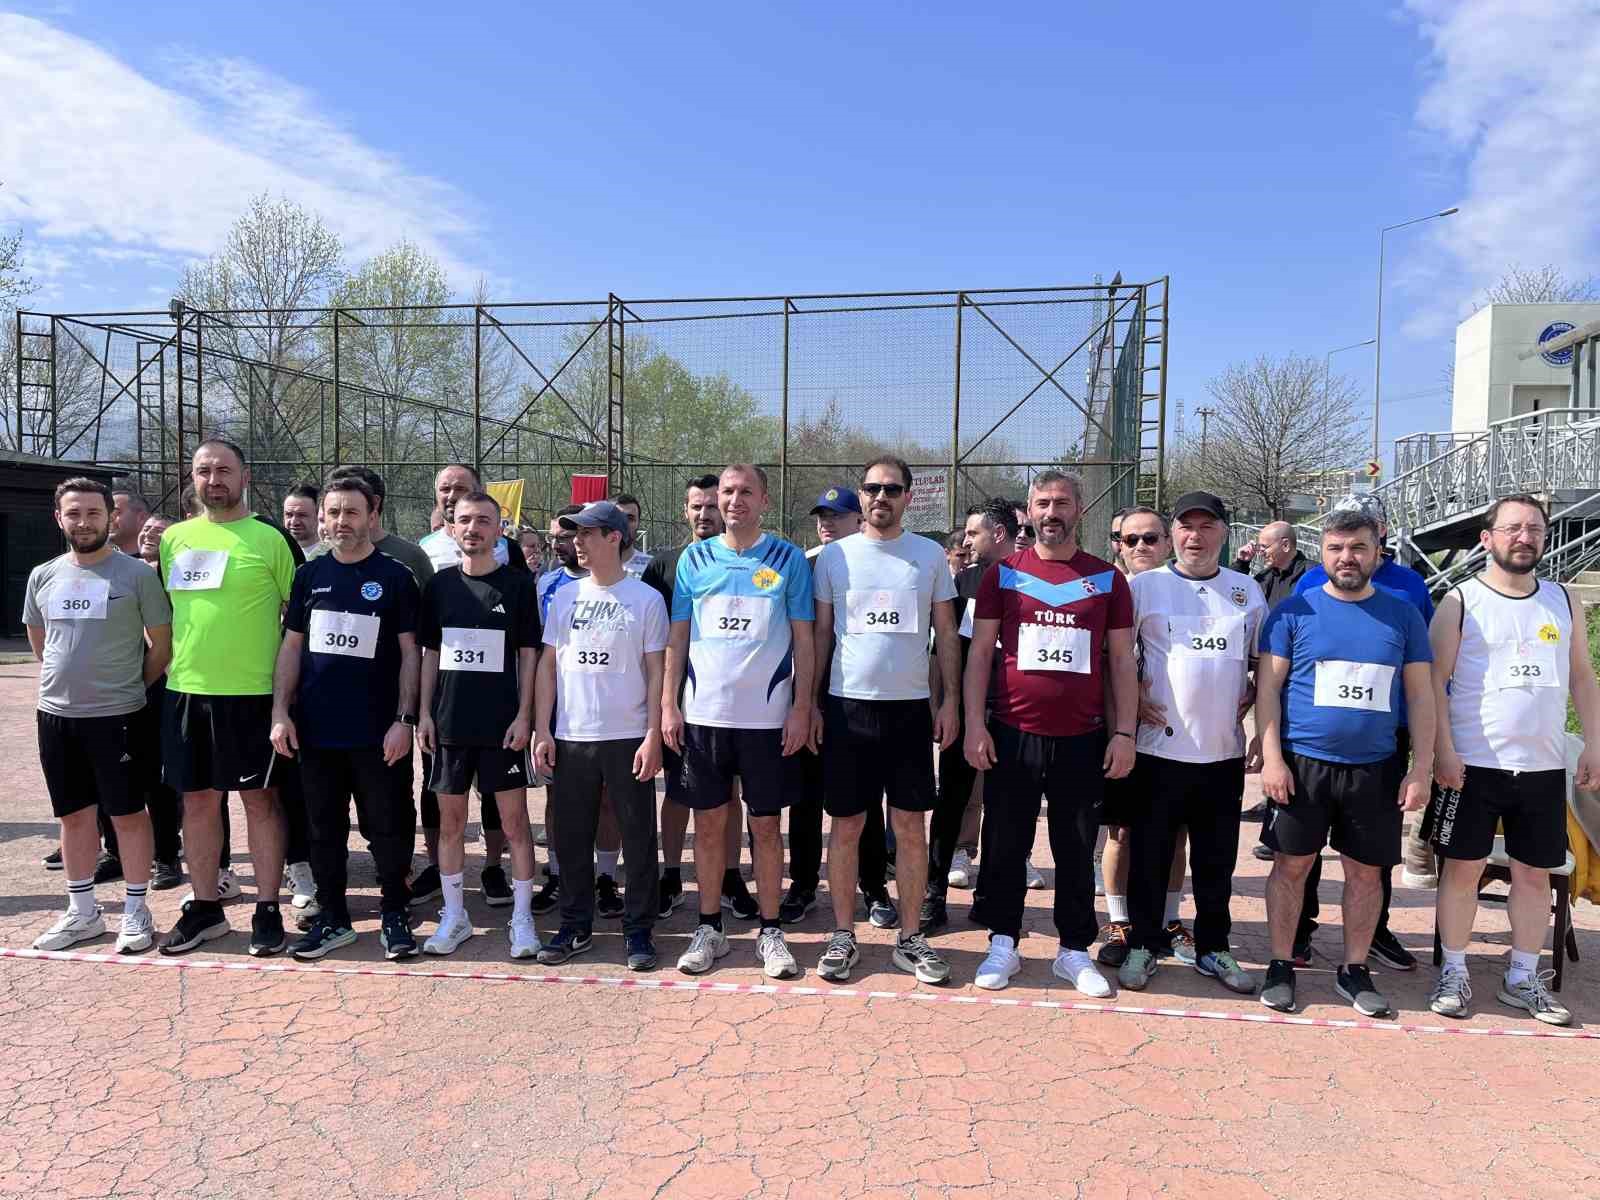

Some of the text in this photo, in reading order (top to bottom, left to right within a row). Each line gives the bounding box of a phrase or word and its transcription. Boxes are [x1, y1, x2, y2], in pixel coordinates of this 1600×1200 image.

[183, 570, 210, 582] 359
[62, 599, 91, 610] 360
[718, 617, 752, 631] 327
[866, 611, 900, 625] 348
[1034, 610, 1076, 625] TÜRK
[325, 633, 359, 648] 309
[1191, 637, 1227, 651] 349
[453, 649, 485, 664] 331
[578, 651, 609, 665] 332
[1037, 648, 1073, 663] 345
[1509, 664, 1541, 677] 323
[1338, 684, 1374, 701] 351
[1439, 819, 1454, 846] HOME
